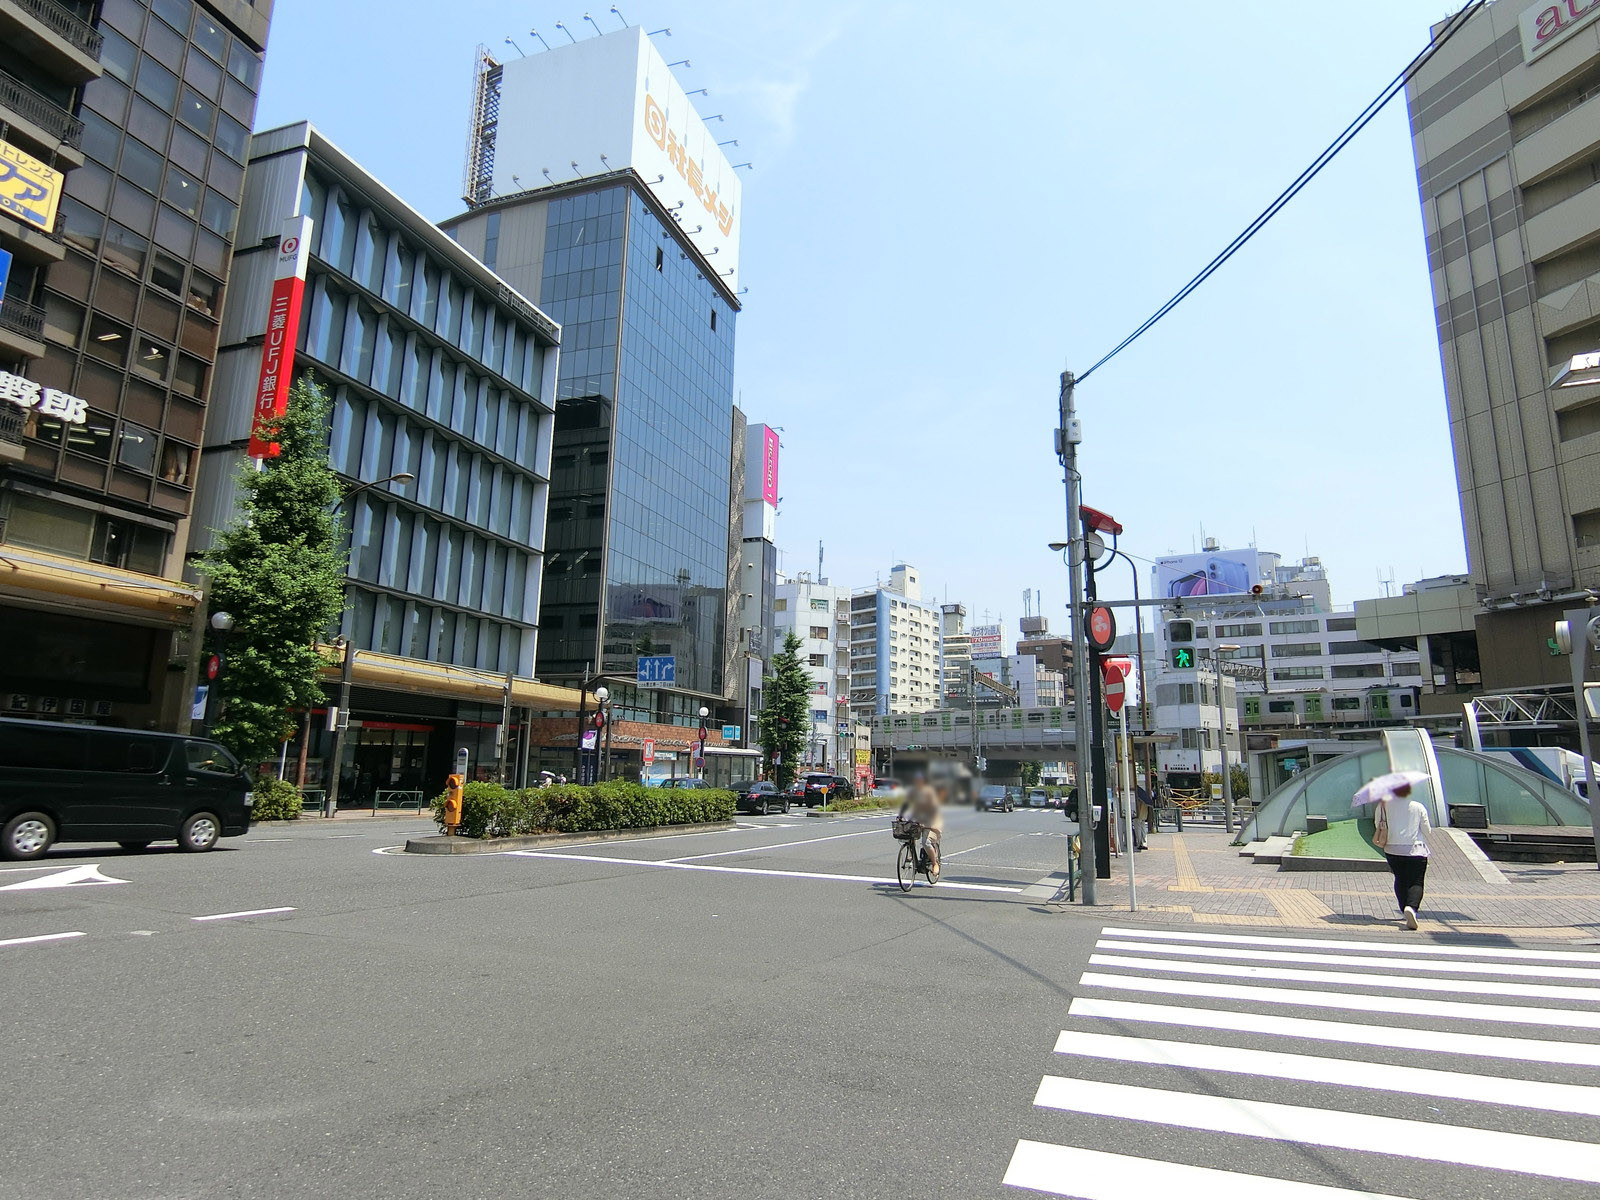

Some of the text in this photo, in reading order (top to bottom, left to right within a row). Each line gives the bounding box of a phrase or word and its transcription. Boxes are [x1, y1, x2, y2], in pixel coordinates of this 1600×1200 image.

[1536, 0, 1600, 40] at
[667, 128, 734, 237] 社長メシ
[280, 254, 298, 263] MUFG
[260, 296, 289, 410] 三菱UFJ銀行
[0, 370, 89, 424] 野郎
